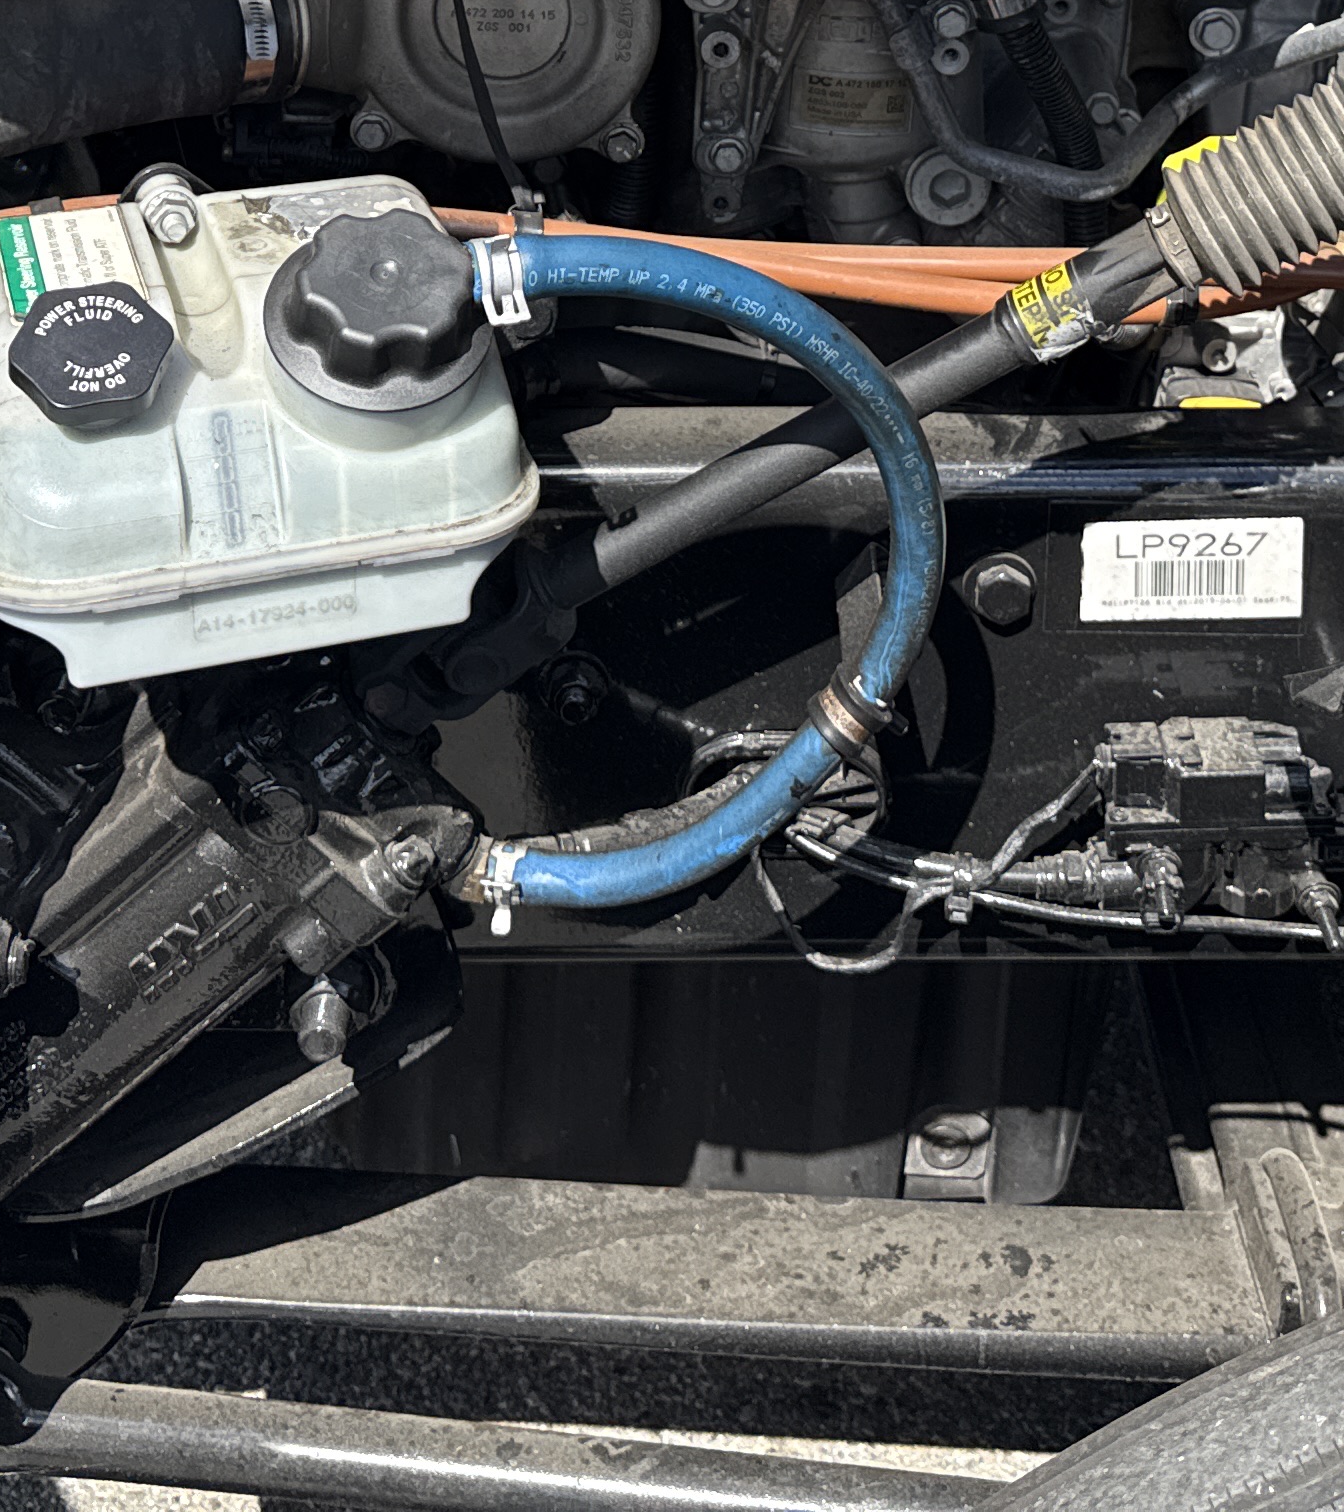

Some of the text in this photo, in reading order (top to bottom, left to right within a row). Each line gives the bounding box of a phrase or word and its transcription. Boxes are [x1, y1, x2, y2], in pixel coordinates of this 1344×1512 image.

[491, 8, 515, 20] 200
[519, 9, 536, 21] 14
[540, 10, 557, 21] 15
[476, 21, 500, 33] ZGS
[808, 74, 833, 87] DC
[34, 295, 145, 337] POWER STEERING
[63, 308, 113, 327] FLUID
[546, 266, 621, 285] HI-TEMP
[628, 268, 651, 286] WP
[731, 294, 767, 319] (350
[768, 311, 805, 339] PSI)
[804, 333, 840, 367] MSHA
[63, 352, 132, 379] OVERFILL
[68, 373, 127, 393] DO NOT
[1115, 531, 1268, 559] LP9267
